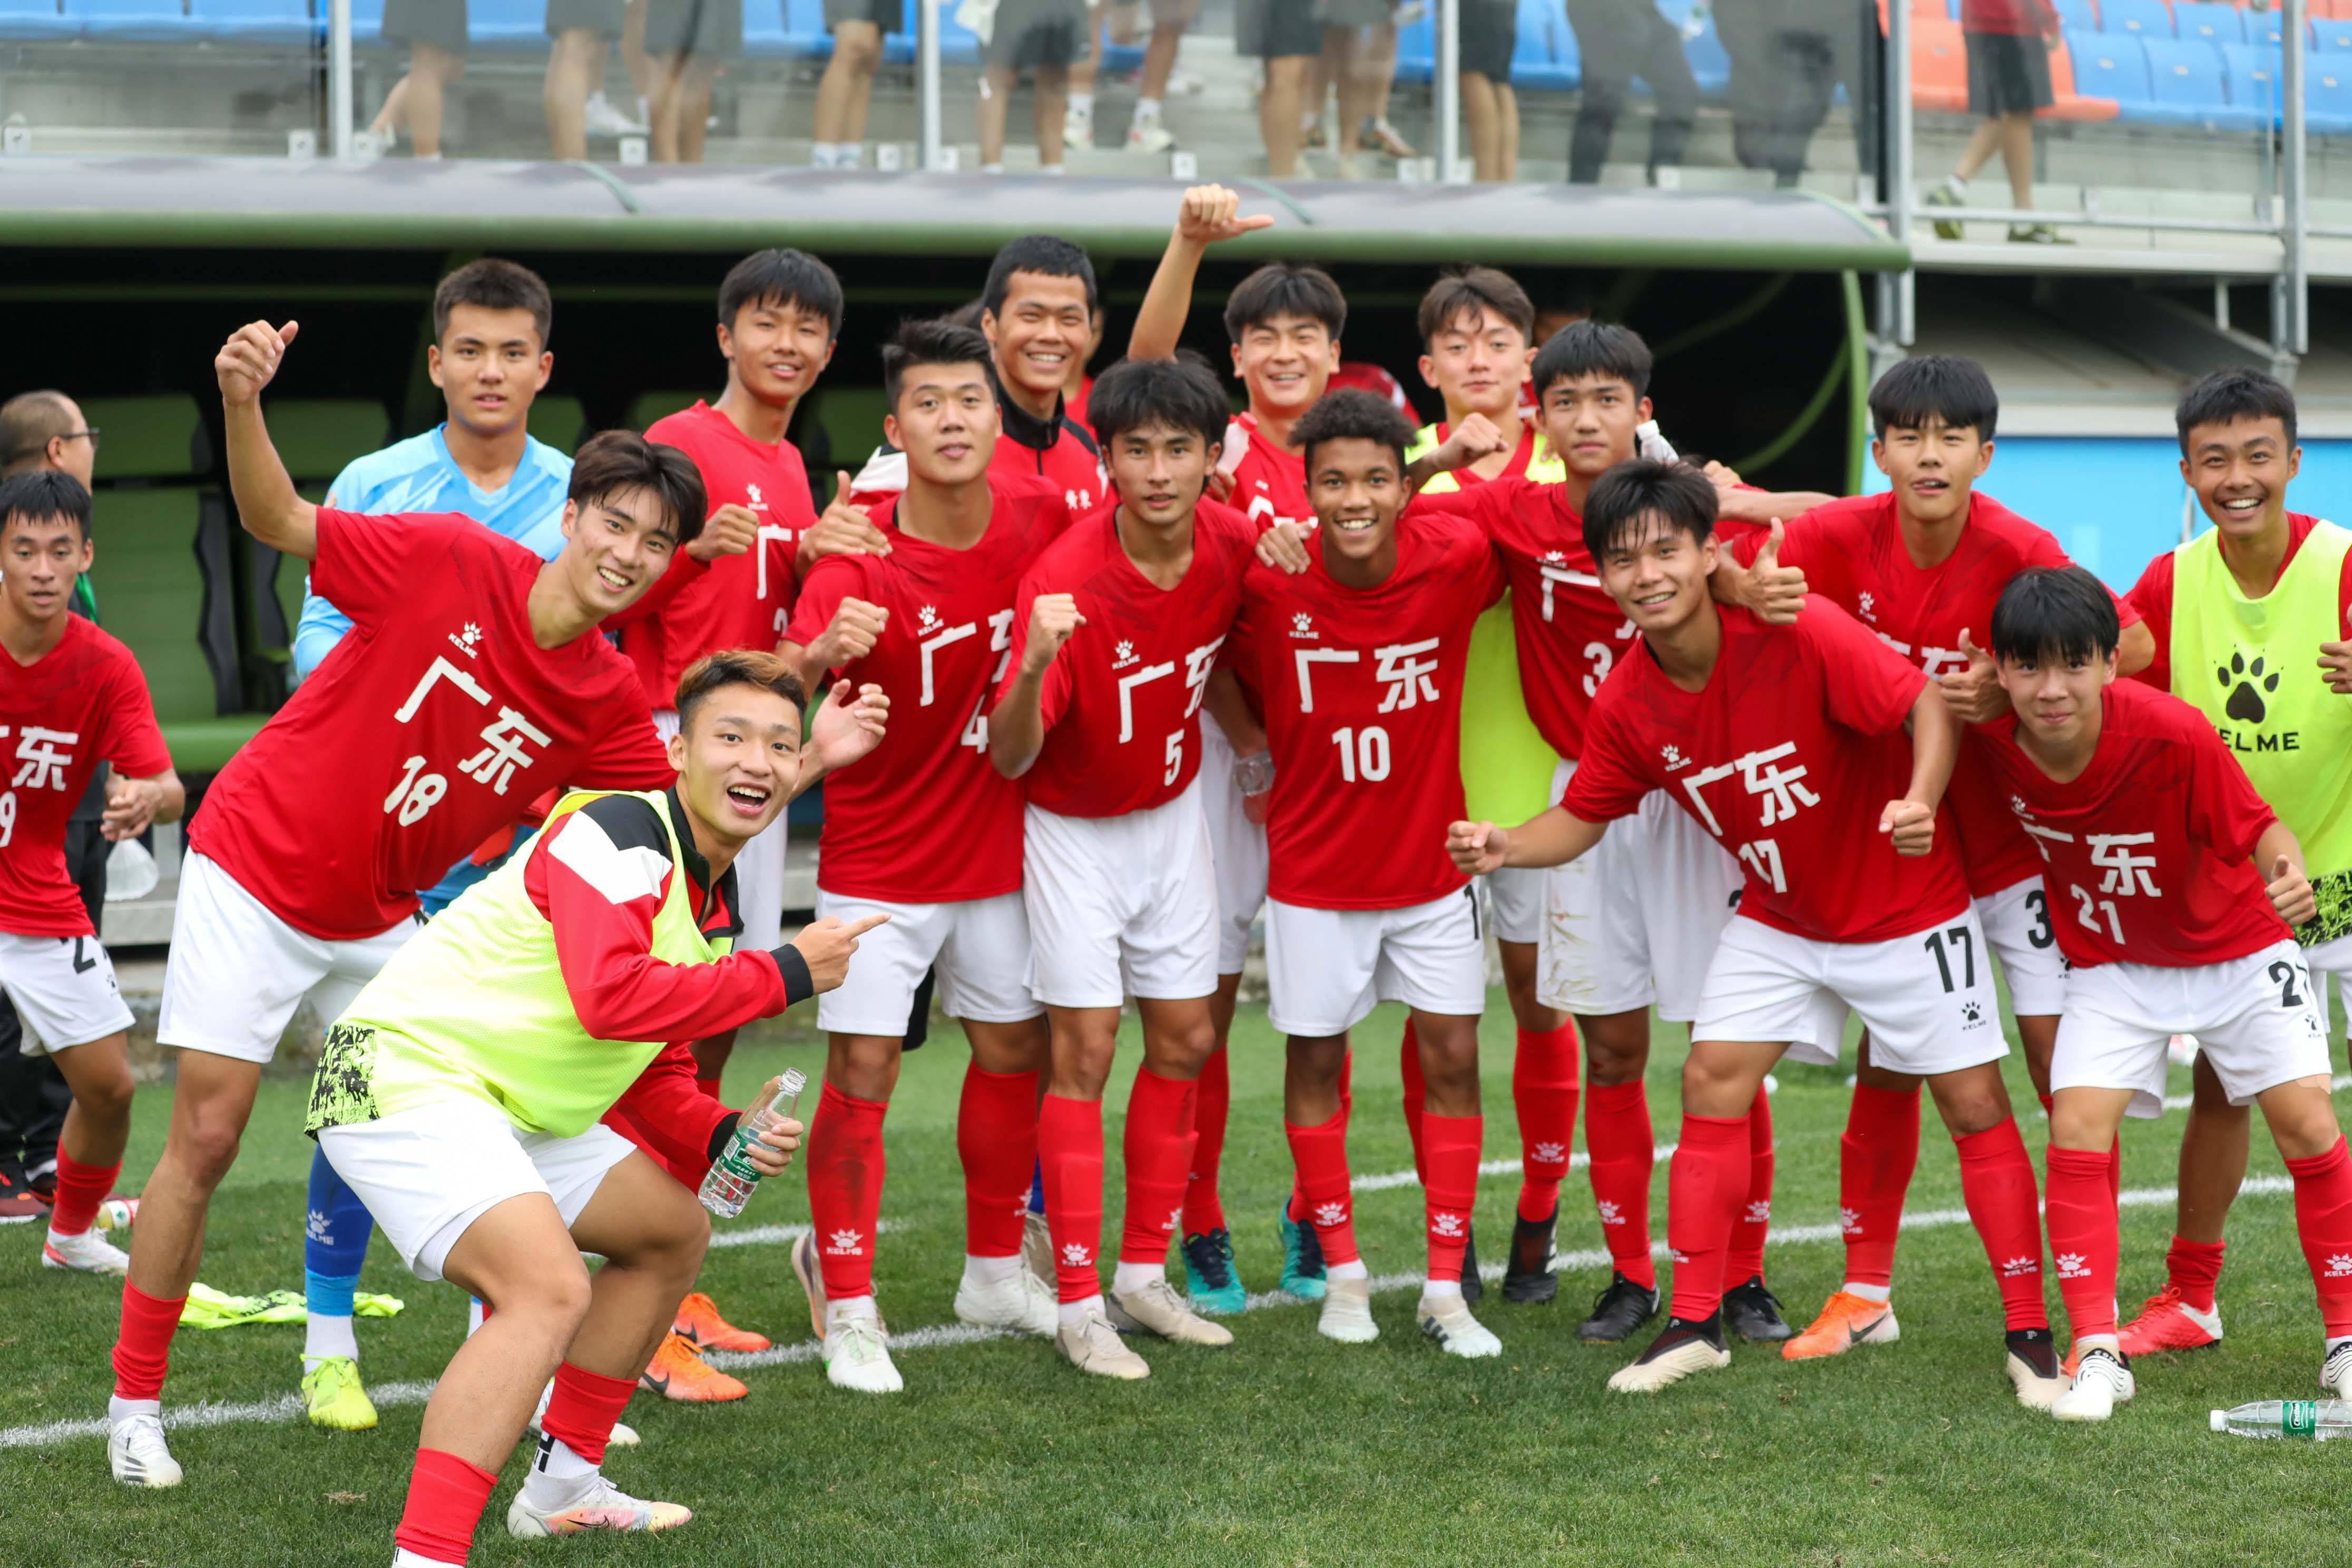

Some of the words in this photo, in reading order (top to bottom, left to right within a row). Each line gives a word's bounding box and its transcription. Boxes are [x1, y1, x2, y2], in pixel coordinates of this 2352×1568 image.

[448, 633, 478, 659] KELME
[917, 618, 944, 636] KELME
[1112, 654, 1140, 670] KELME
[1295, 637, 1439, 714] 广东
[394, 655, 552, 796] 广东
[961, 693, 989, 754] 4
[2215, 727, 2300, 752] ELME
[1164, 728, 1184, 787] 5
[1331, 726, 1391, 782] 10
[1665, 757, 1692, 772] KELME
[384, 755, 448, 827] 18
[1681, 740, 1821, 836] 广东
[1738, 838, 1787, 894] 17
[2071, 883, 2126, 945] 21
[1924, 926, 1975, 993] 17
[826, 1246, 863, 1255] KELME
